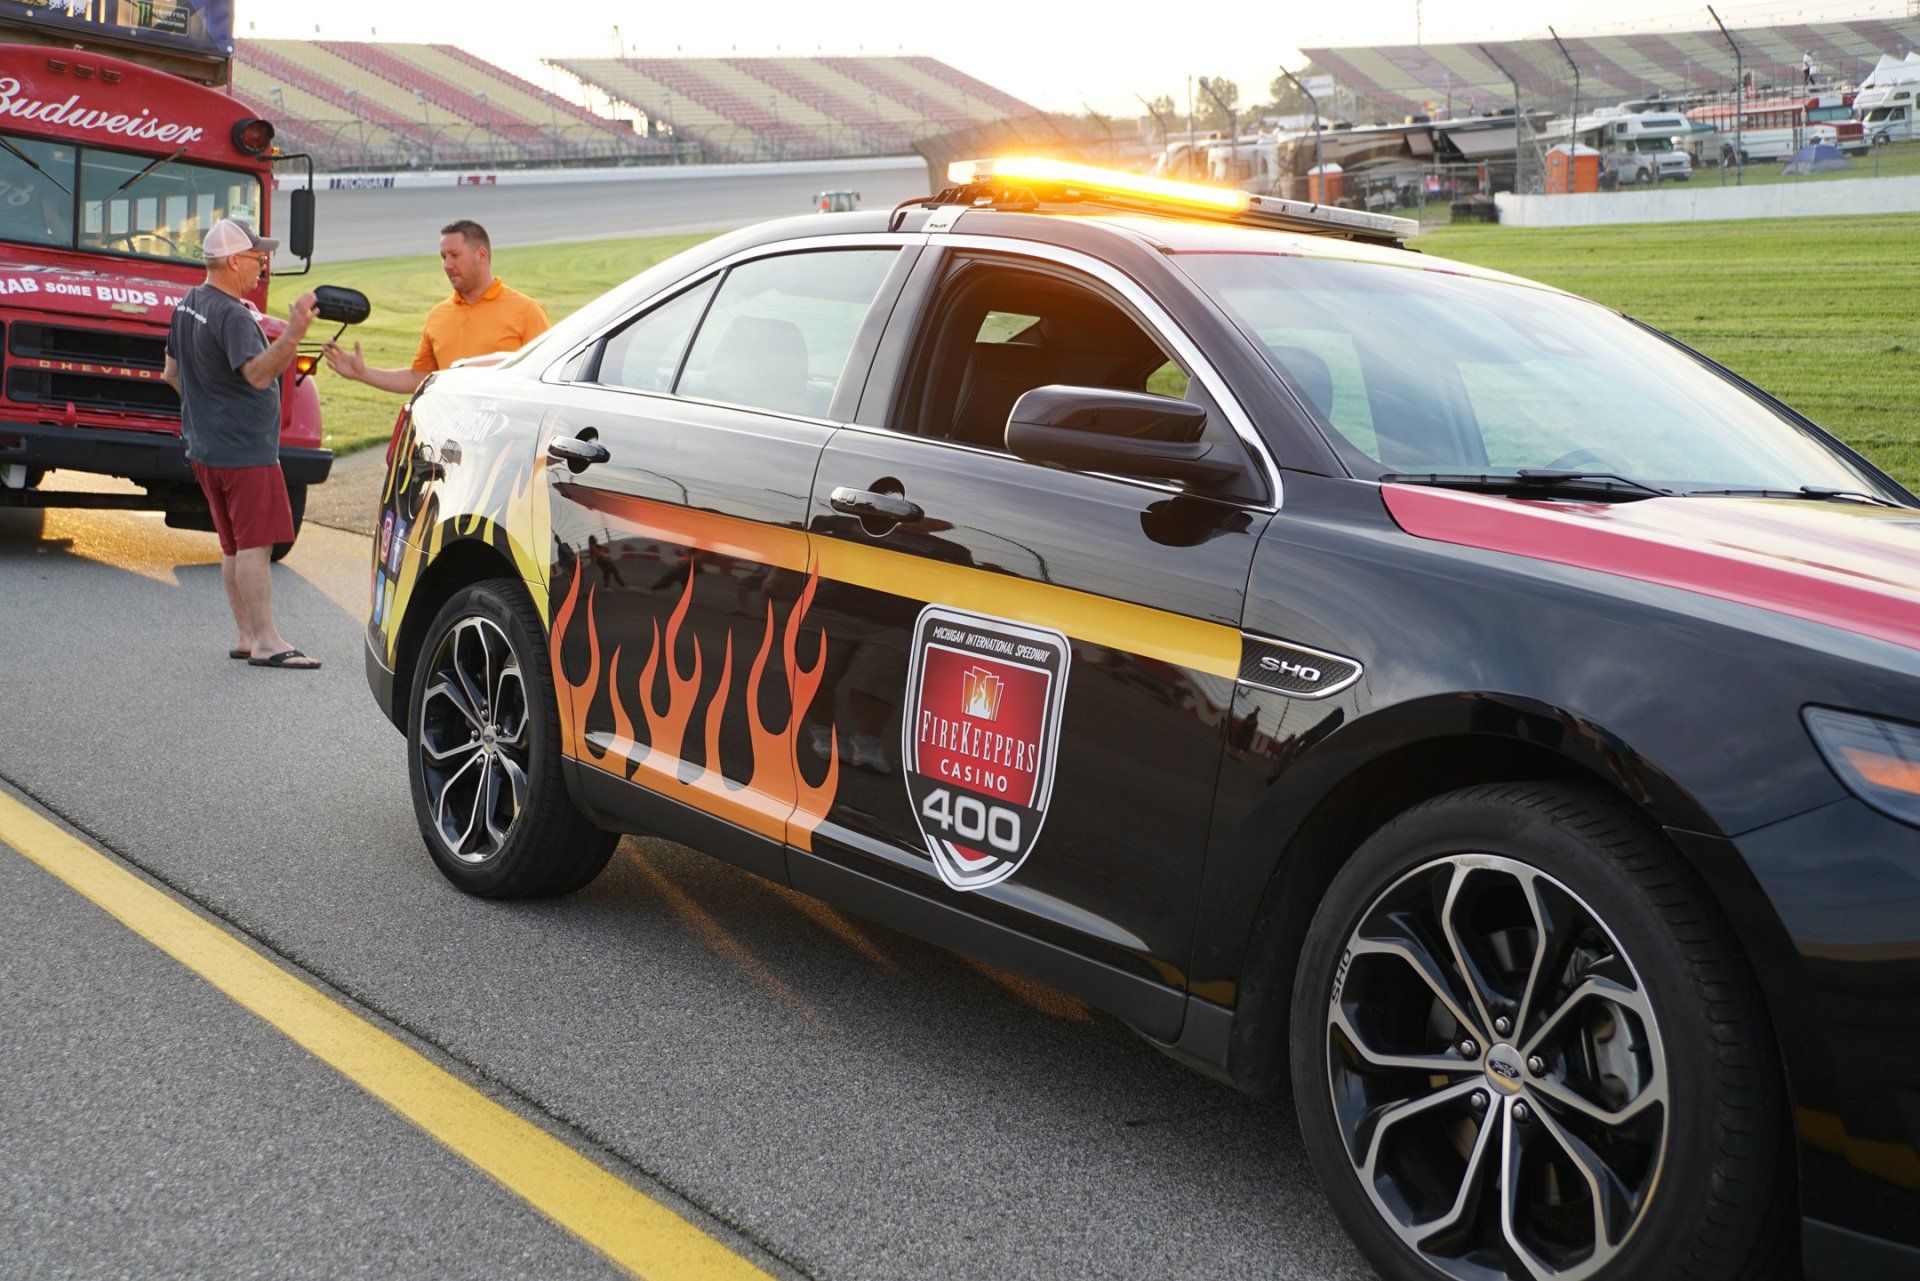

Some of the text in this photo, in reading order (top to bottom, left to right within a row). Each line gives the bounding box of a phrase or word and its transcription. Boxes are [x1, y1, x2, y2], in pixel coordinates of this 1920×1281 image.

[0, 77, 204, 144] Budweiser
[45, 282, 92, 297] SOME
[96, 286, 159, 306] BUDS
[932, 626, 1051, 662] MICHIGAN INTERNATIONAL SPEEDWAY
[1260, 656, 1321, 681] SHO
[940, 758, 1008, 793] CASINO
[922, 788, 1021, 852] 400
[1331, 948, 1351, 1004] SHO
